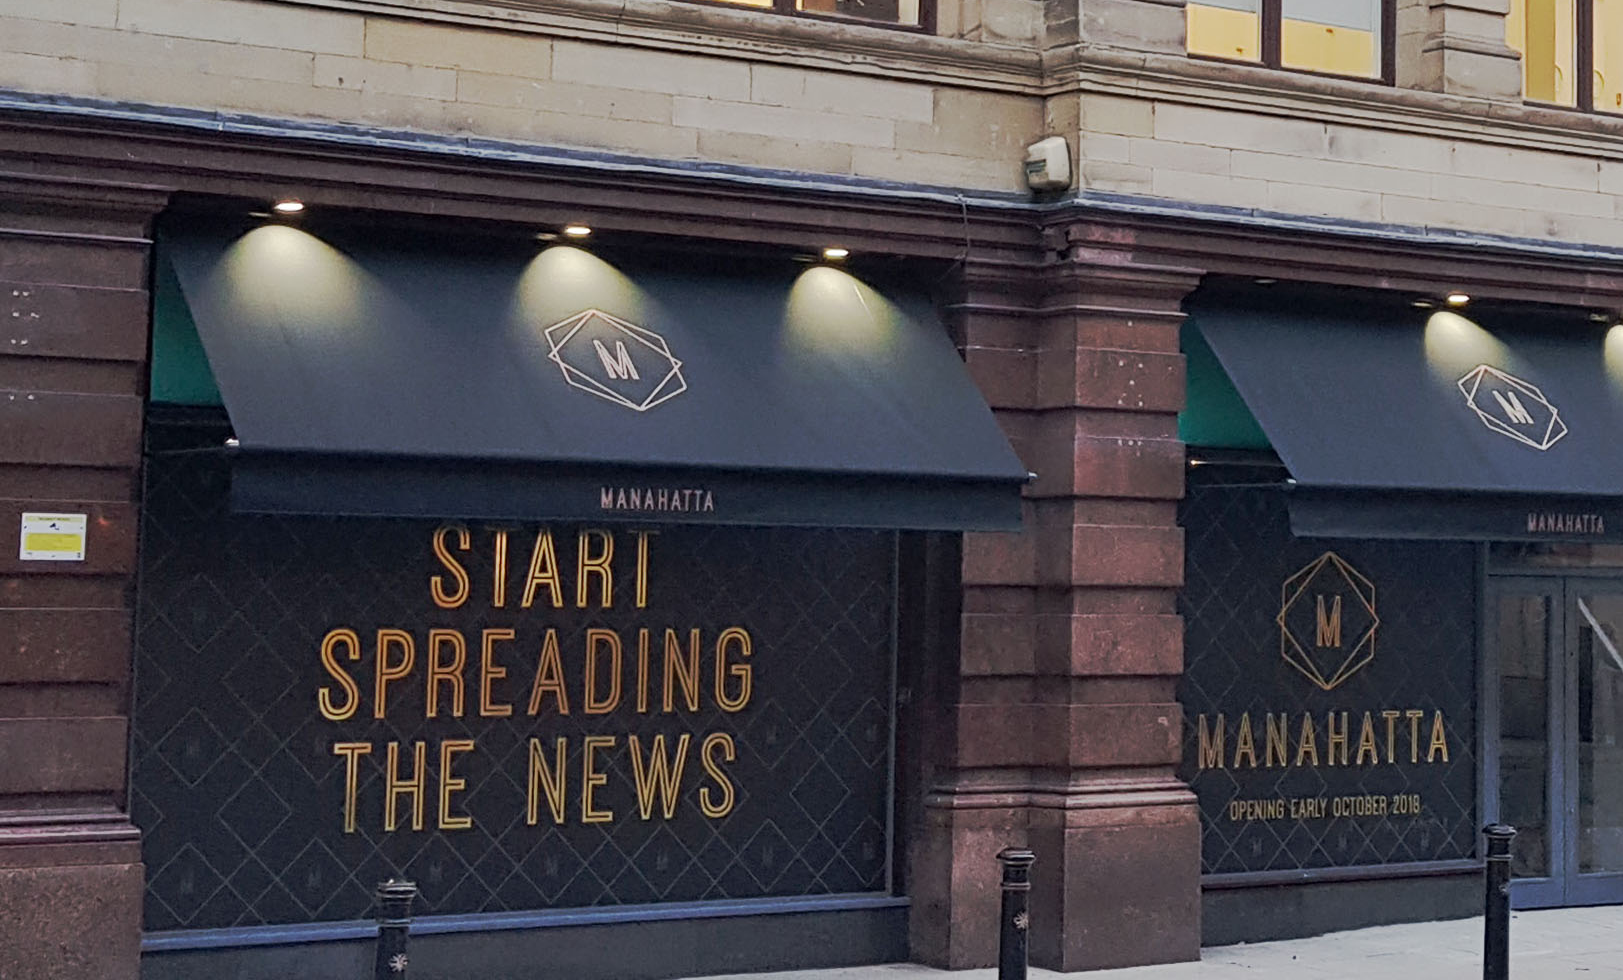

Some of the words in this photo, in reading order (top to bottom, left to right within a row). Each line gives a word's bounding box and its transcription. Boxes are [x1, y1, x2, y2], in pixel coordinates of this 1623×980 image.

[592, 339, 640, 380] M
[600, 486, 714, 512] MANAHATTA
[1527, 512, 1605, 533] MANAHATTA
[431, 524, 661, 609] START
[1316, 594, 1342, 648] M
[318, 627, 752, 721] SPREADING
[1199, 709, 1449, 769] MANAHATTA
[334, 739, 475, 834] THE
[527, 732, 736, 826] NEWS
[1229, 799, 1285, 821] OPENING
[1290, 797, 1328, 819] EARLY
[1333, 795, 1387, 817] OCTOBER
[1393, 794, 1420, 814] 2018
